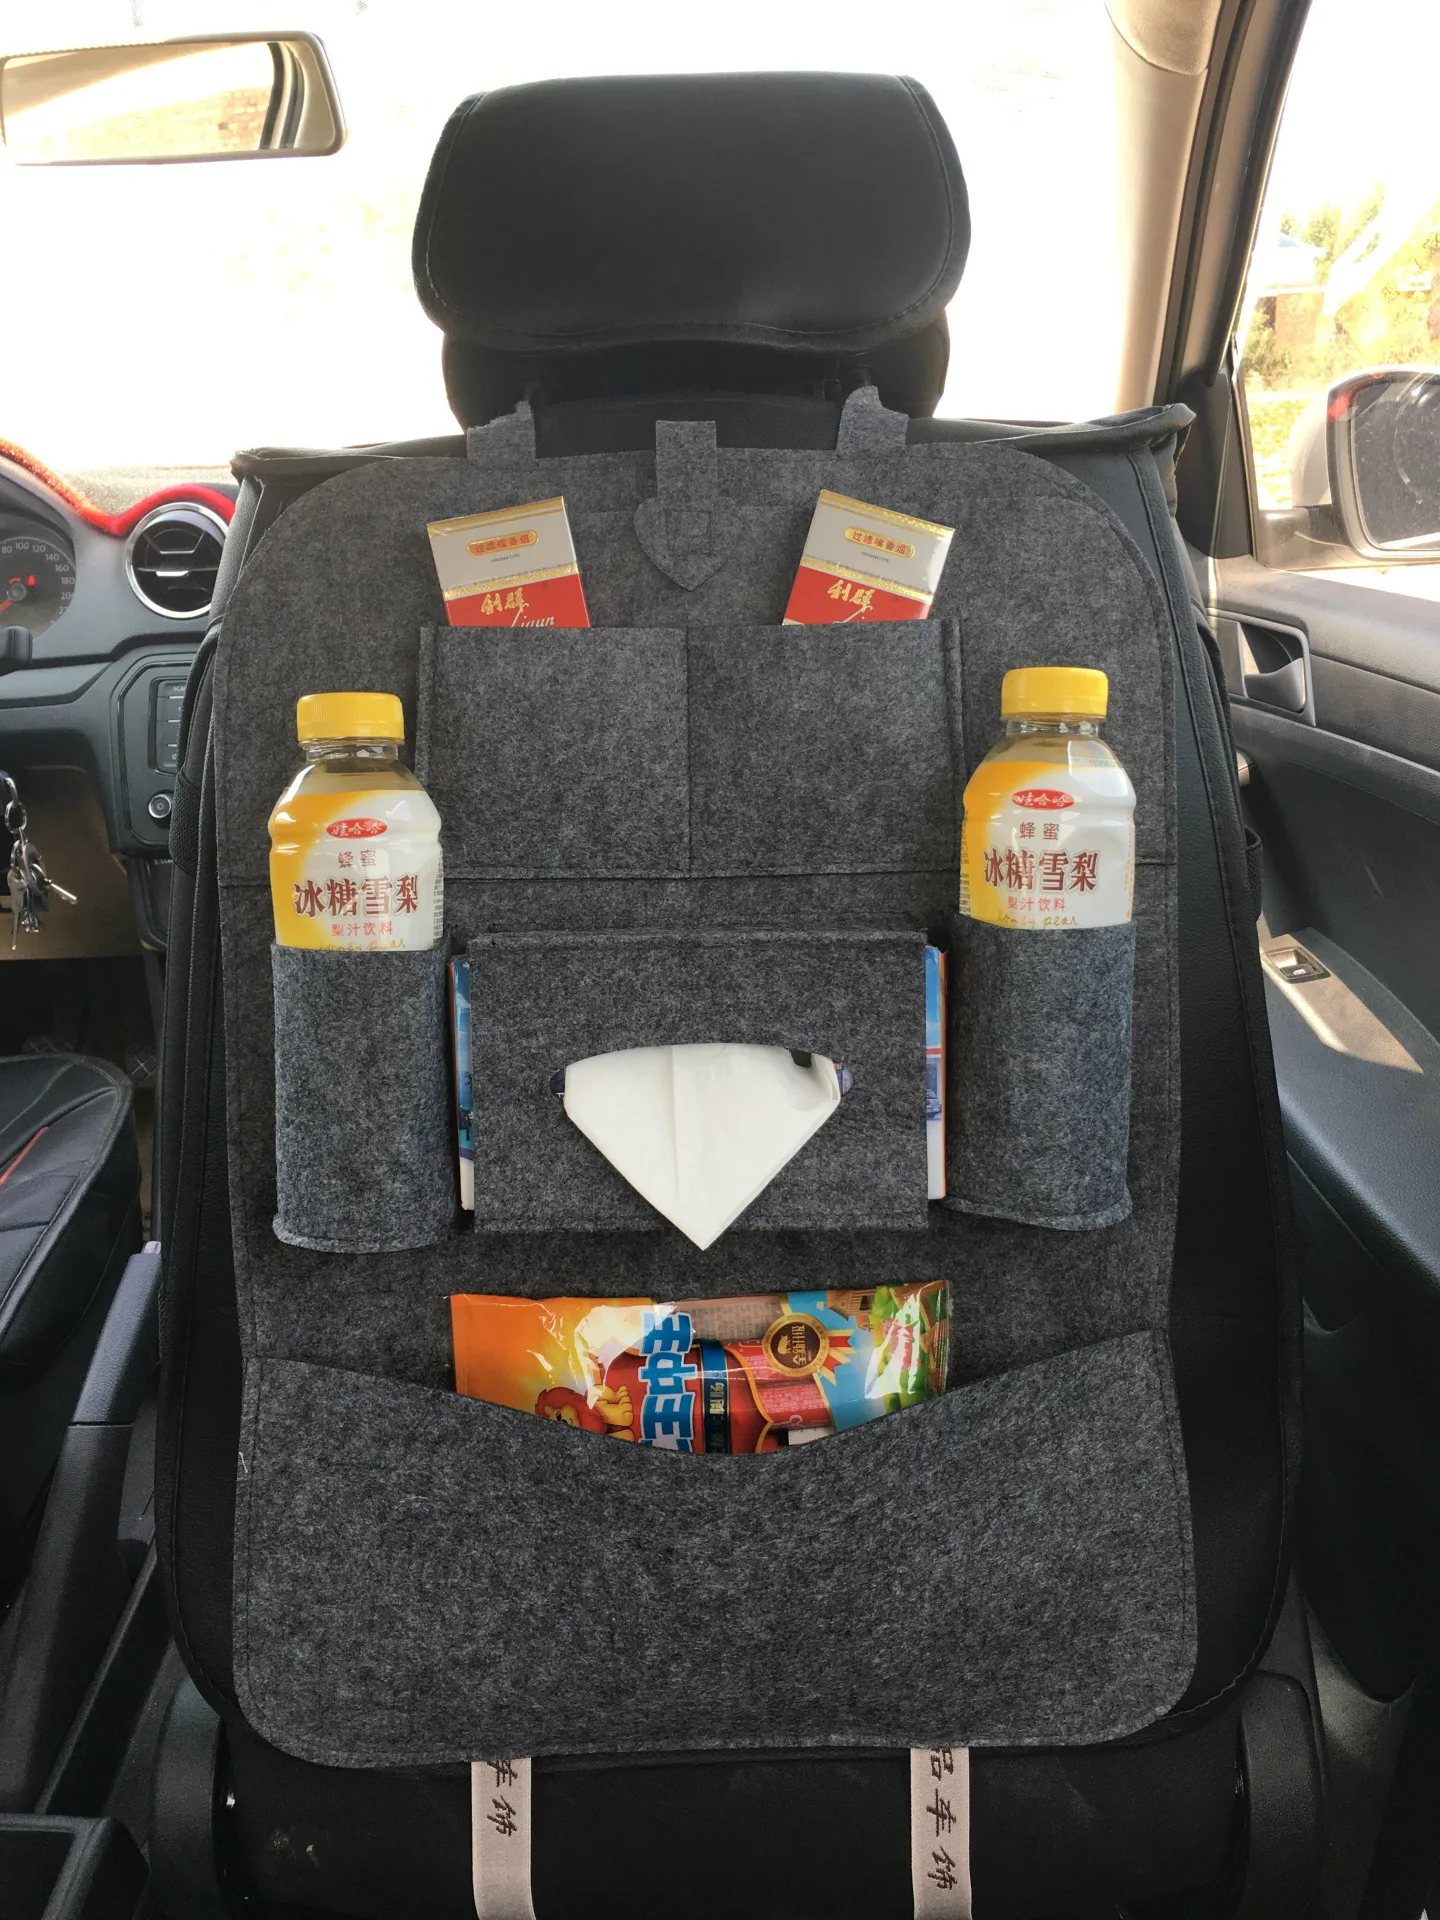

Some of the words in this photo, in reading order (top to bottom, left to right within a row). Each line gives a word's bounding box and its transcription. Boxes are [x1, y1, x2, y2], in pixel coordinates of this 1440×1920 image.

[1, 545, 13, 554] 80
[15, 542, 30, 550] 100
[32, 544, 46, 553] 120
[852, 531, 907, 554] 过滤嘴香烟
[45, 553, 60, 561] 140
[55, 564, 69, 572] 160
[61, 577, 75, 585] 180
[1014, 791, 1070, 807] 娃哈哈
[331, 822, 382, 837] 娃哈哈
[1019, 822, 1060, 840] 蜂蜜
[338, 850, 376, 868] 蜂蜜
[983, 848, 1099, 893] 冰糖雪梨
[293, 874, 419, 918] 冰糖雪梨
[1007, 896, 1065, 912] 梨汁饮料
[331, 921, 394, 937] 梨汁饮料
[791, 1324, 807, 1366] 全新升级
[638, 1312, 698, 1452] 王中王
